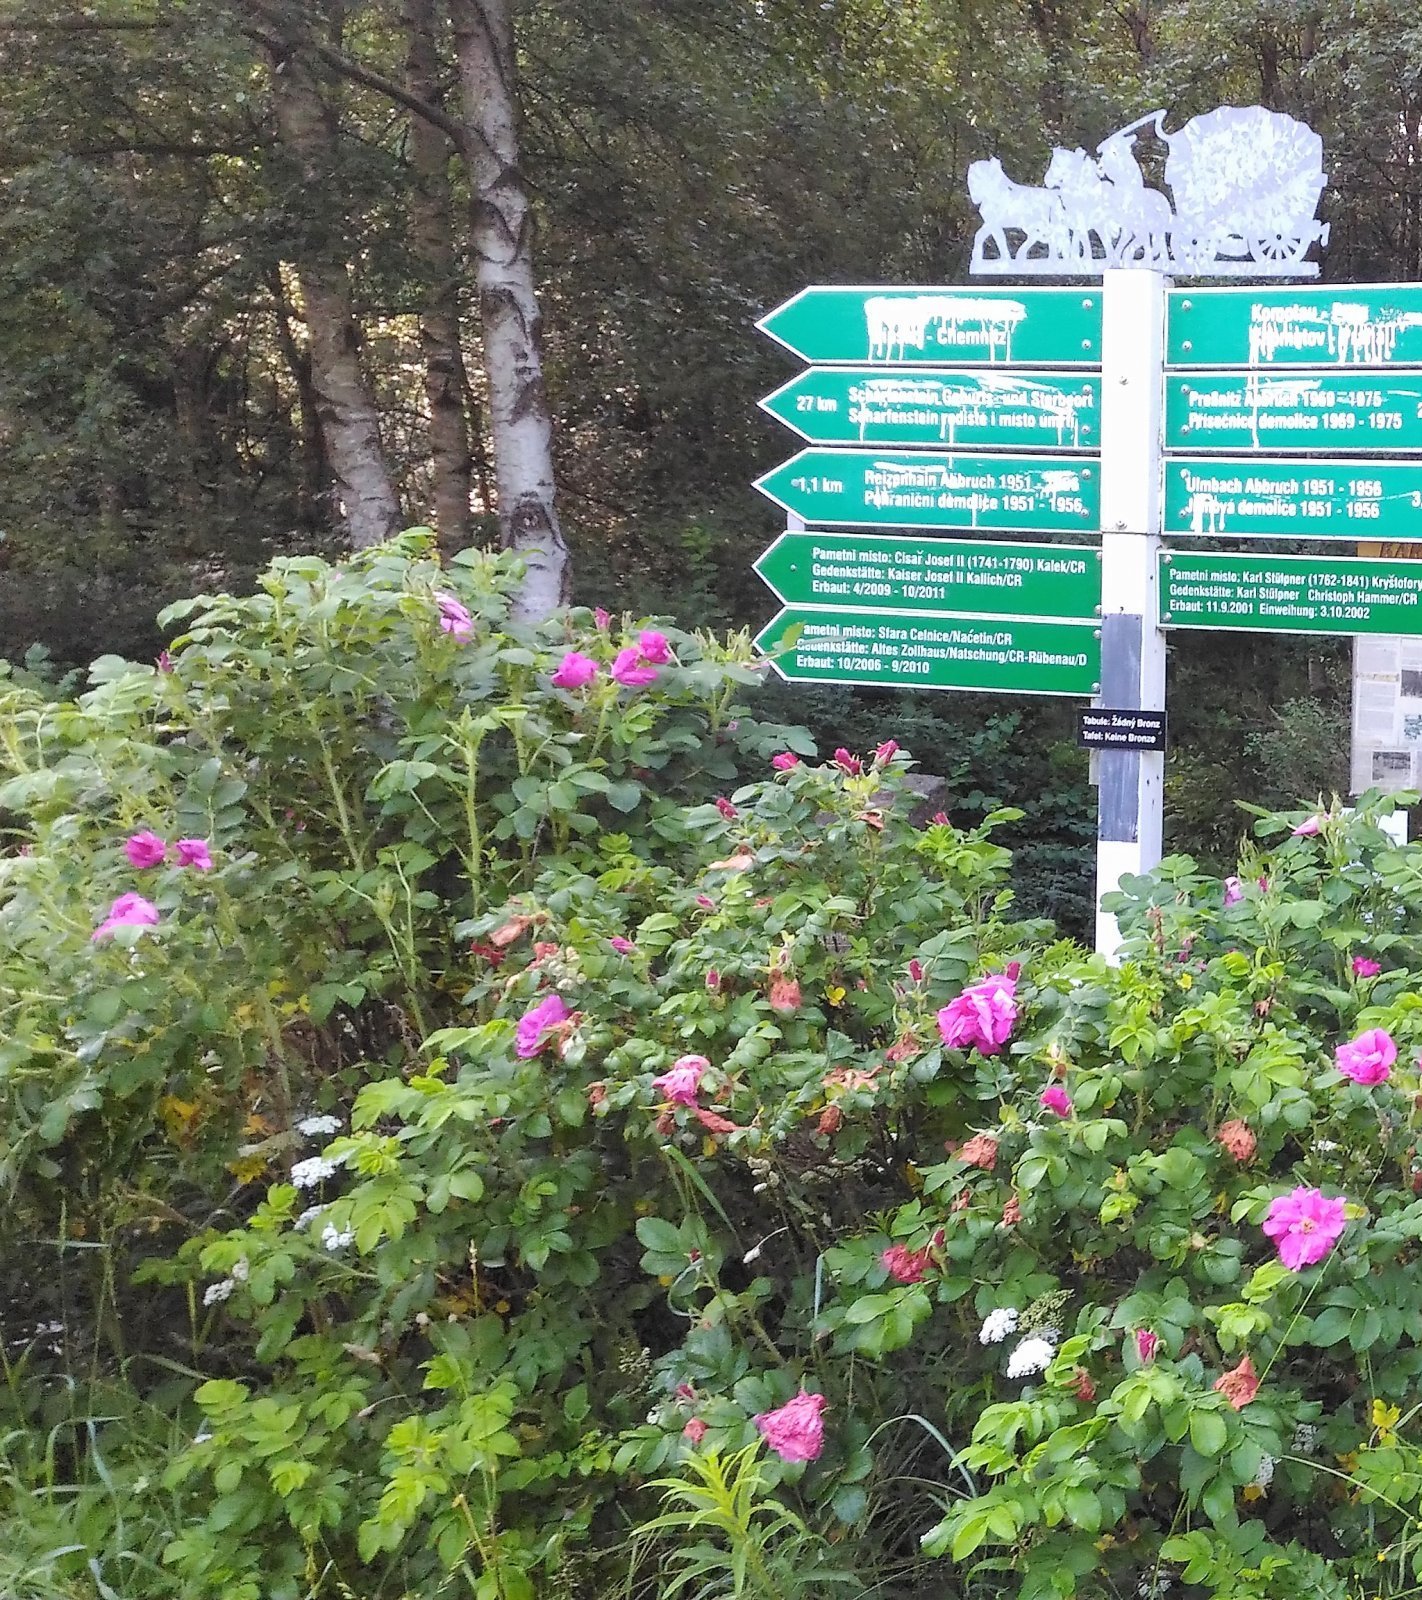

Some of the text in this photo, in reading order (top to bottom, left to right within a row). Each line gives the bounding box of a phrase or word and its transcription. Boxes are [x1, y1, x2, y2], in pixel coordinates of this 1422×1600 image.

[936, 326, 1007, 345] Chemnitz
[796, 396, 837, 412] 27 km
[1258, 412, 1318, 429] demolice
[1321, 412, 1355, 430] 1969
[1369, 413, 1403, 430] 1975
[798, 477, 843, 494] 1,1 km
[940, 472, 996, 489] Abbruch
[999, 474, 1031, 490] 1951
[1186, 476, 1242, 493] Ulmbach
[1245, 478, 1299, 494] Abbruch
[1302, 480, 1334, 495] 1951
[1348, 480, 1382, 496] 1956
[937, 492, 998, 510] demolice
[1002, 495, 1034, 511] 1951
[1048, 496, 1083, 513] 1956
[1238, 499, 1297, 516] demolice
[1300, 501, 1332, 517] 1951
[1346, 502, 1380, 519] 1956
[925, 553, 954, 567] Josef
[956, 555, 965, 567] II
[967, 555, 1034, 573] (1741-1790)
[812, 564, 1022, 587] Gedenkstätte: Kaiser Josef II Kallich/CR
[1242, 571, 1263, 584] Karl
[1264, 572, 1305, 586] Stülpner
[1308, 573, 1369, 588] (1762-1841)
[812, 580, 850, 594] Erbaut:
[852, 582, 891, 596] 4/2009
[901, 585, 946, 599] 10/2011
[1169, 584, 1418, 605] Gedenkstätte: Karl Stülpner Christoph Hammer/CR
[1169, 599, 1371, 620] Erbaut: 11.9.2001 Einweihung: 3.10.2002
[803, 623, 840, 637] ametni
[871, 642, 899, 656] Altes
[901, 644, 1087, 666] Zollhaus/Natschung/CR-Rübenau/D
[797, 655, 835, 669] Erbaut:
[837, 657, 882, 671] 10/2006
[891, 660, 930, 674] 9/2010
[1082, 715, 1111, 726] Tabule:
[1137, 718, 1161, 729] Bronz
[1082, 730, 1156, 744] Tafel: Keine Bronze
